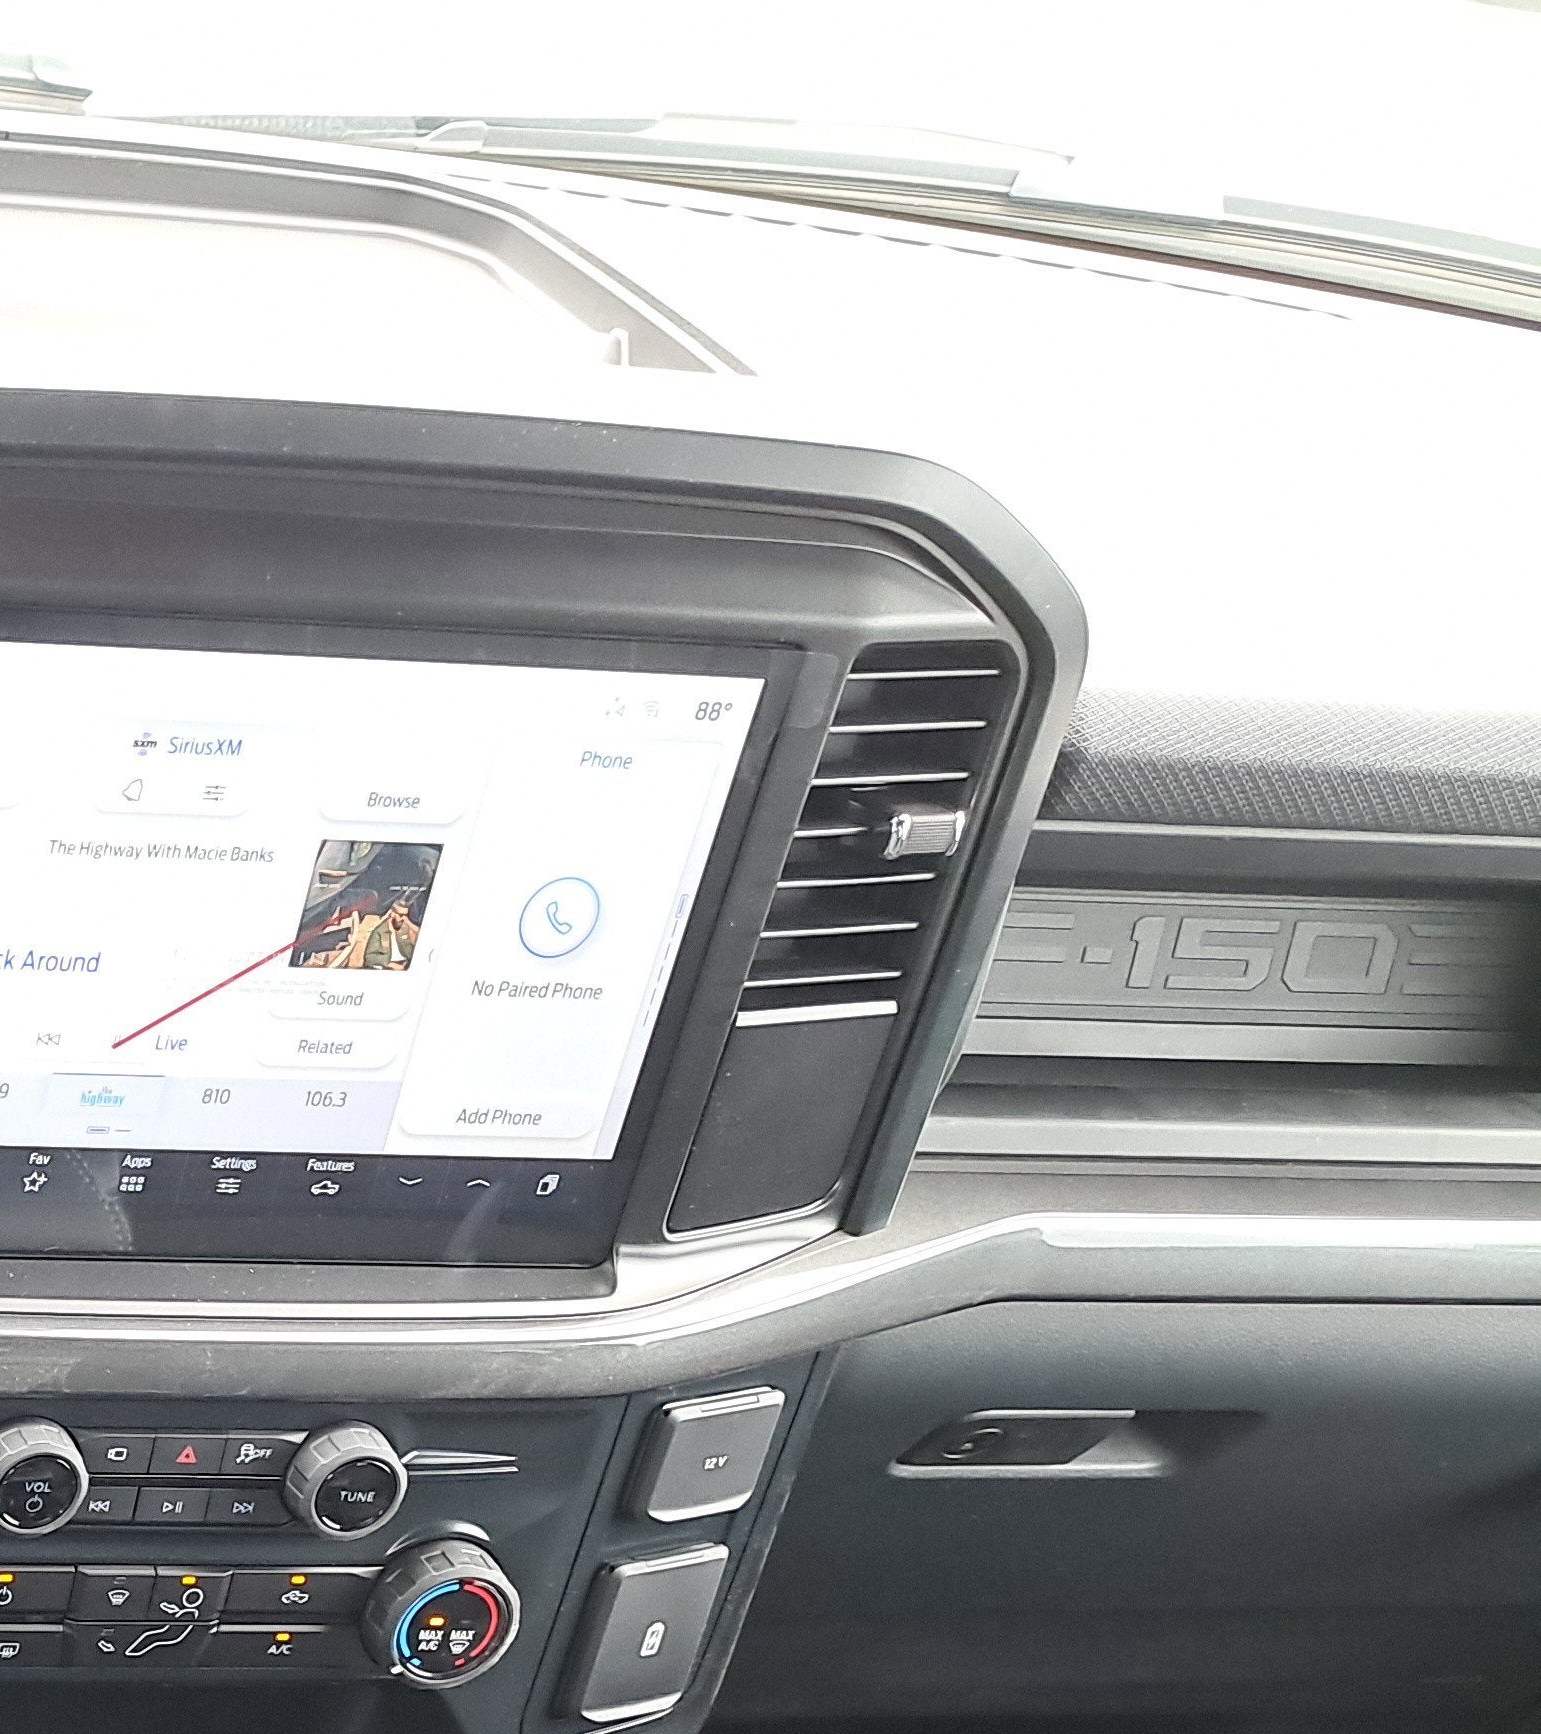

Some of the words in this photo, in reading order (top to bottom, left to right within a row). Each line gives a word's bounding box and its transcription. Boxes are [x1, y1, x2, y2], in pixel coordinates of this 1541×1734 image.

[167, 736, 243, 756] SiriusXM
[579, 750, 633, 771] Phone
[367, 791, 421, 810] Browse
[49, 839, 75, 856] The
[79, 841, 143, 860] Highway
[147, 843, 181, 859] With
[184, 845, 227, 861] Macie
[230, 846, 275, 863] Banks
[20, 949, 102, 973] Around
[317, 990, 364, 1007] Sound
[471, 980, 495, 998] No
[497, 981, 548, 1000] Paired
[551, 983, 603, 1000] Phone
[155, 1034, 188, 1051] Live
[297, 1039, 353, 1055] Related
[201, 1087, 231, 1105] 810
[305, 1090, 348, 1109] 106.3
[456, 1108, 488, 1125] Add
[492, 1110, 543, 1126] Phone
[28, 1152, 51, 1165] Fav
[121, 1154, 152, 1170] Apps
[211, 1156, 258, 1172] Settings
[307, 1158, 356, 1173] Features
[24, 1480, 52, 1494] VOL
[339, 1490, 376, 1504] TUNE
[418, 1629, 444, 1641] MAX
[268, 1643, 293, 1657] A/C
